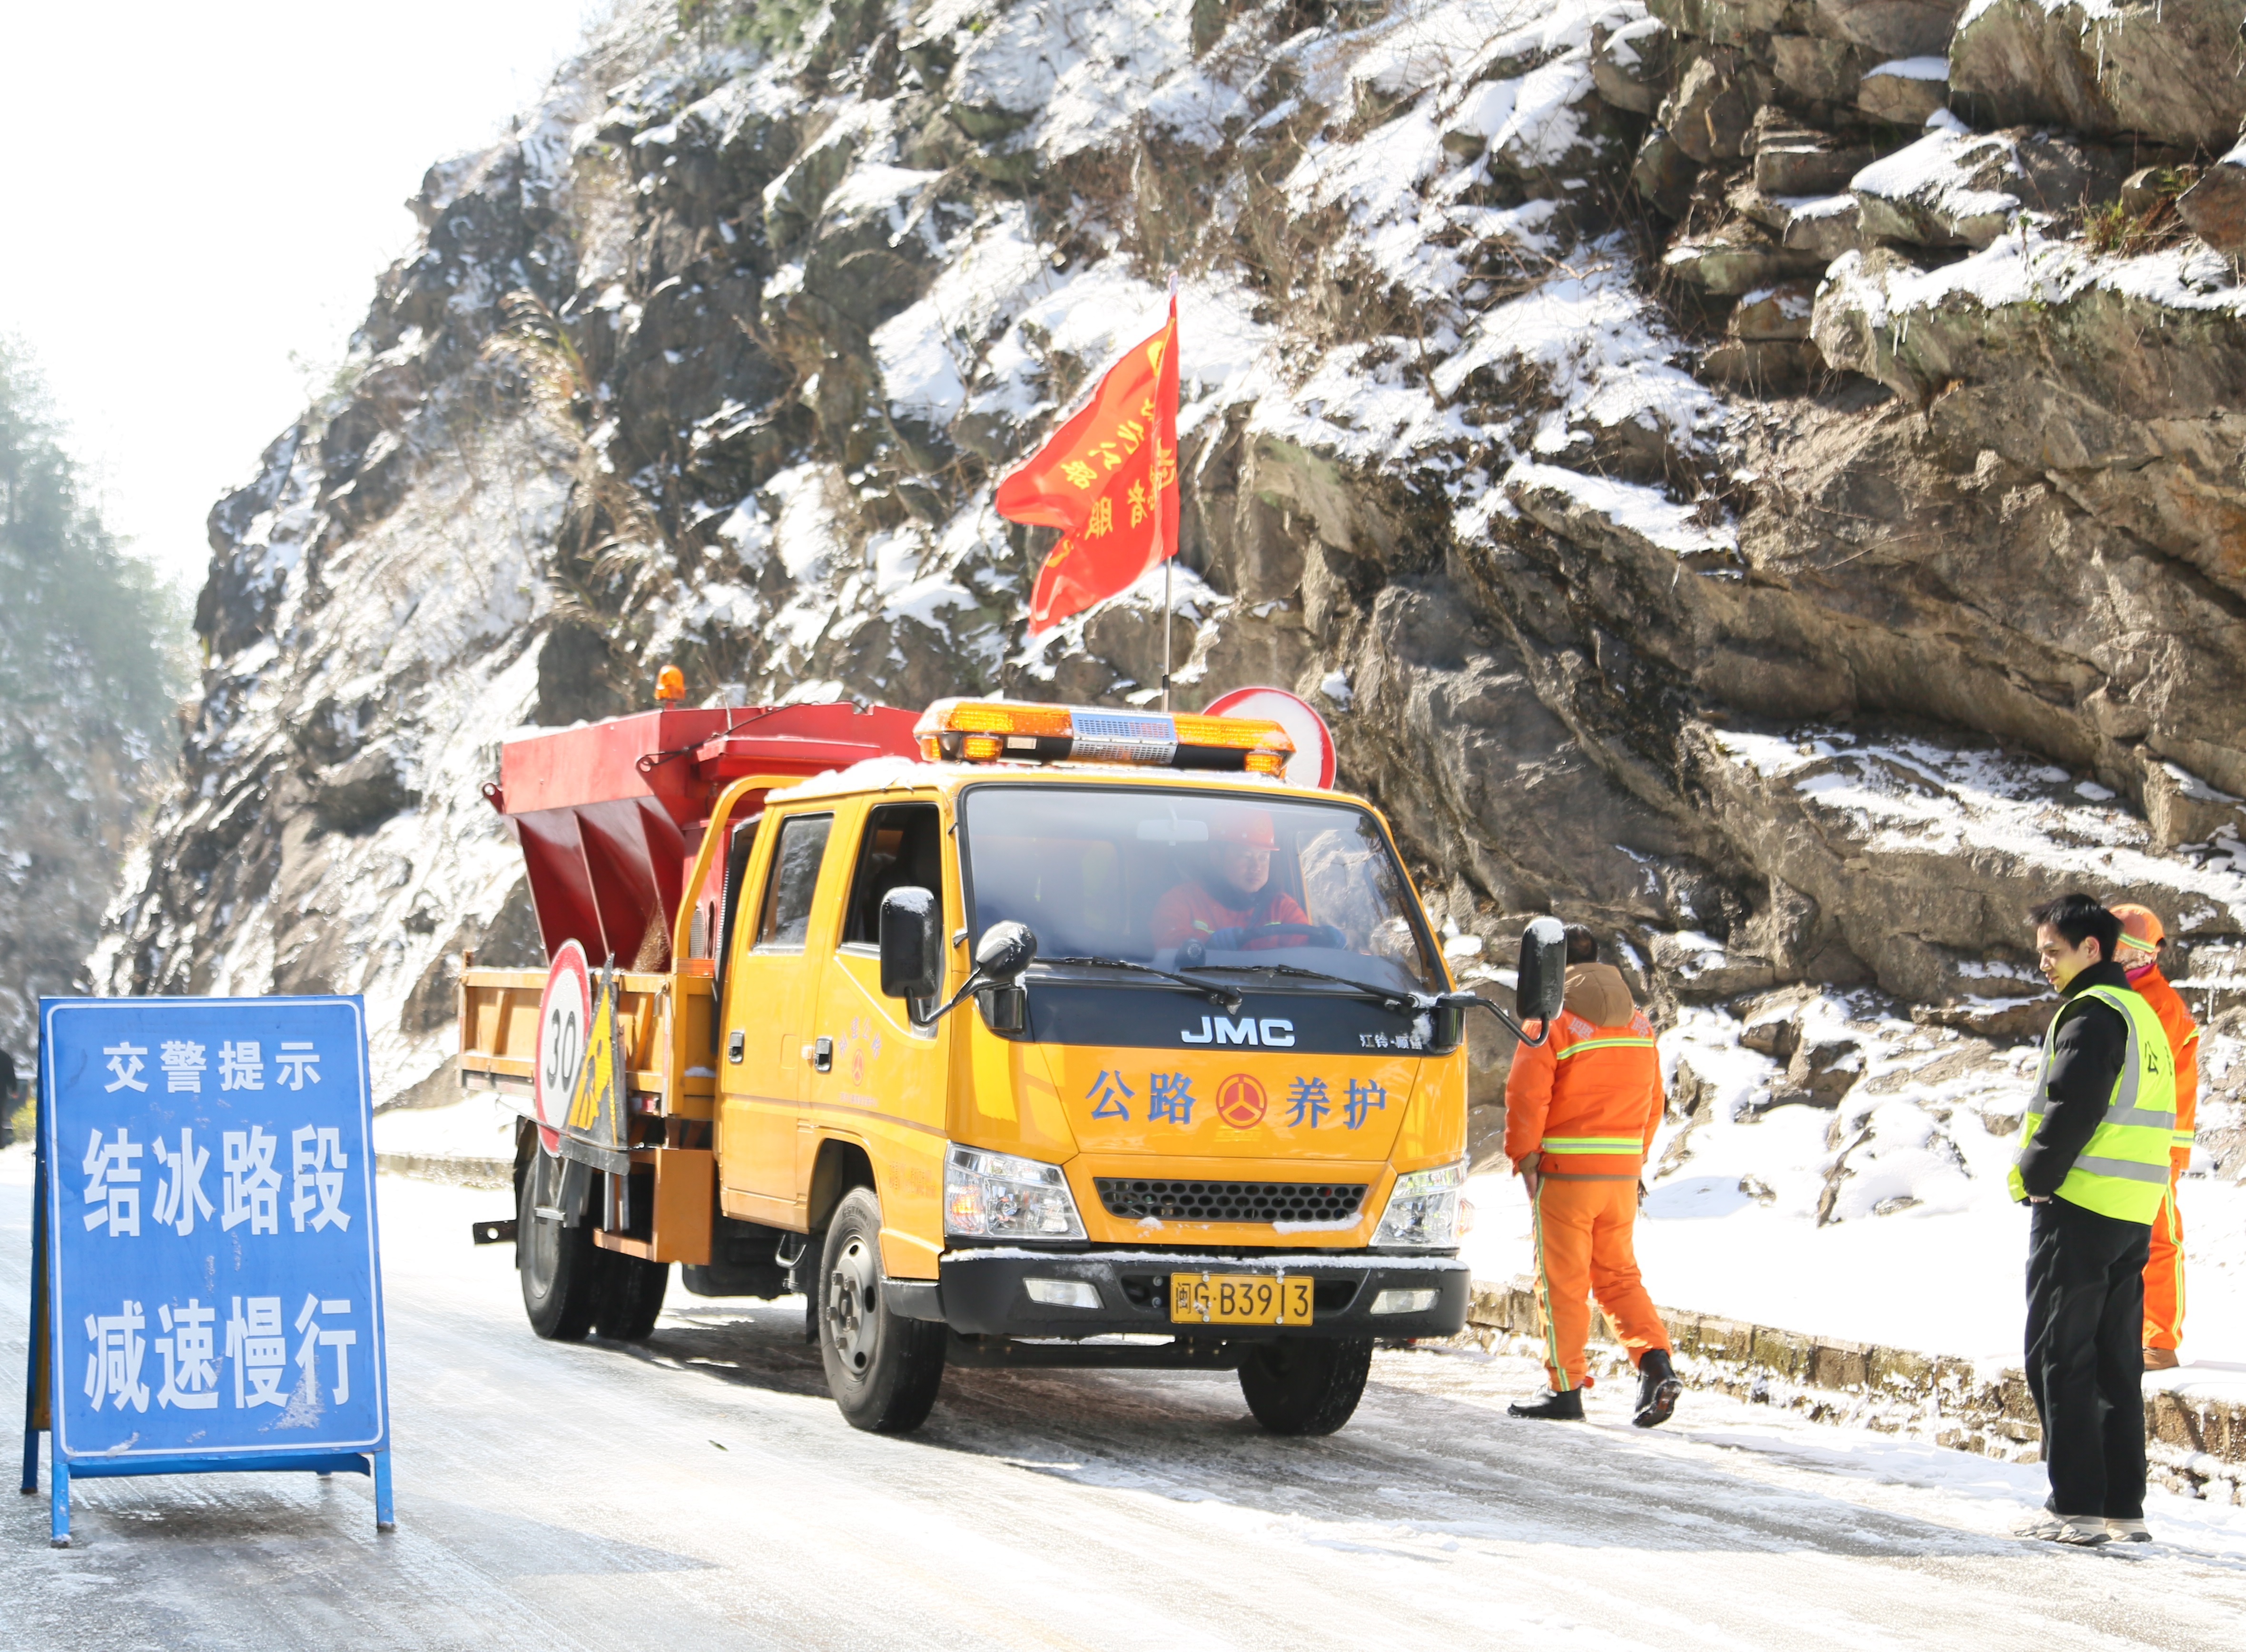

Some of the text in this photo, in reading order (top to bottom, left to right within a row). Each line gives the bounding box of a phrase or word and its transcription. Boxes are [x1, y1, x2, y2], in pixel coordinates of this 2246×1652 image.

[103, 1041, 321, 1093] 交警提示
[547, 1009, 576, 1093] 30
[1181, 1016, 1296, 1047] JMC
[1085, 1069, 1388, 1131] 公路 养护
[81, 1124, 352, 1237] 结冰路段
[84, 1293, 357, 1414] 减速慢行
